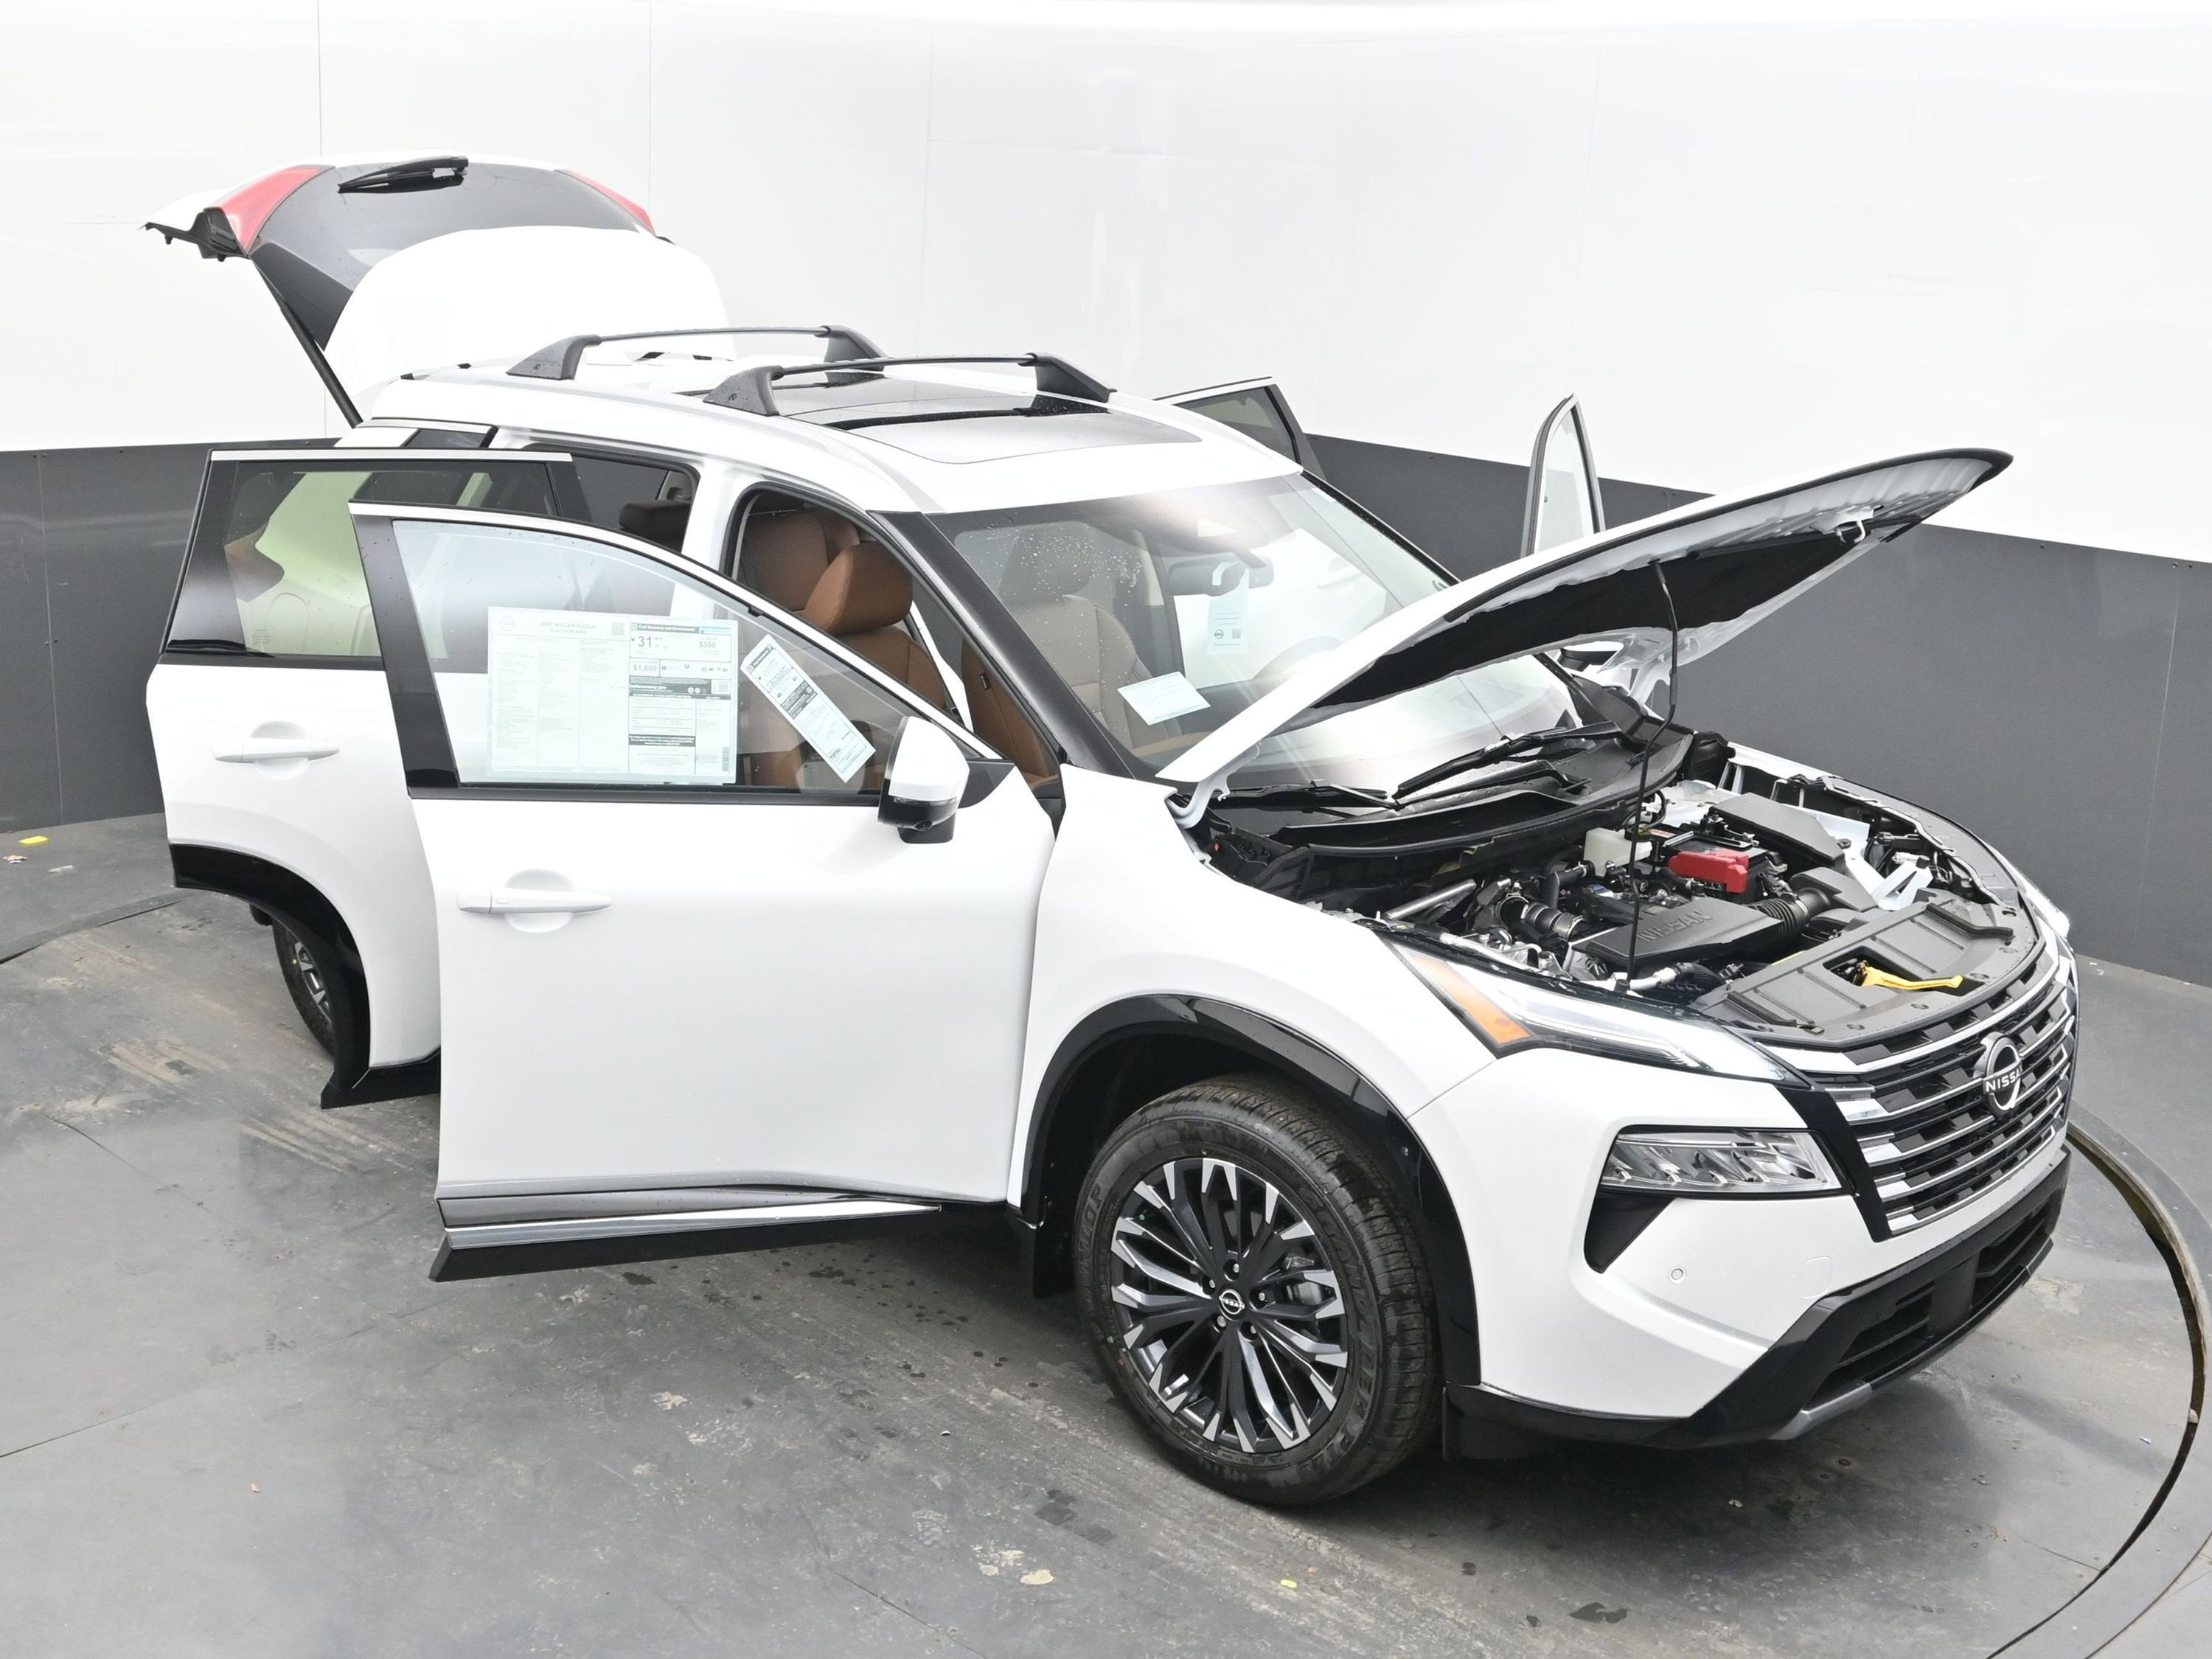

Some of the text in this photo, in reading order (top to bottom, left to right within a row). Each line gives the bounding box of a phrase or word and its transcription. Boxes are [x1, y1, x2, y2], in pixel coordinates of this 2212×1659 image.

[637, 636, 652, 647] 31
[699, 641, 717, 649] $500
[633, 664, 657, 672] $1,600
[1637, 909, 1713, 943] NISSAN
[1985, 1068, 2022, 1093] NISSA
